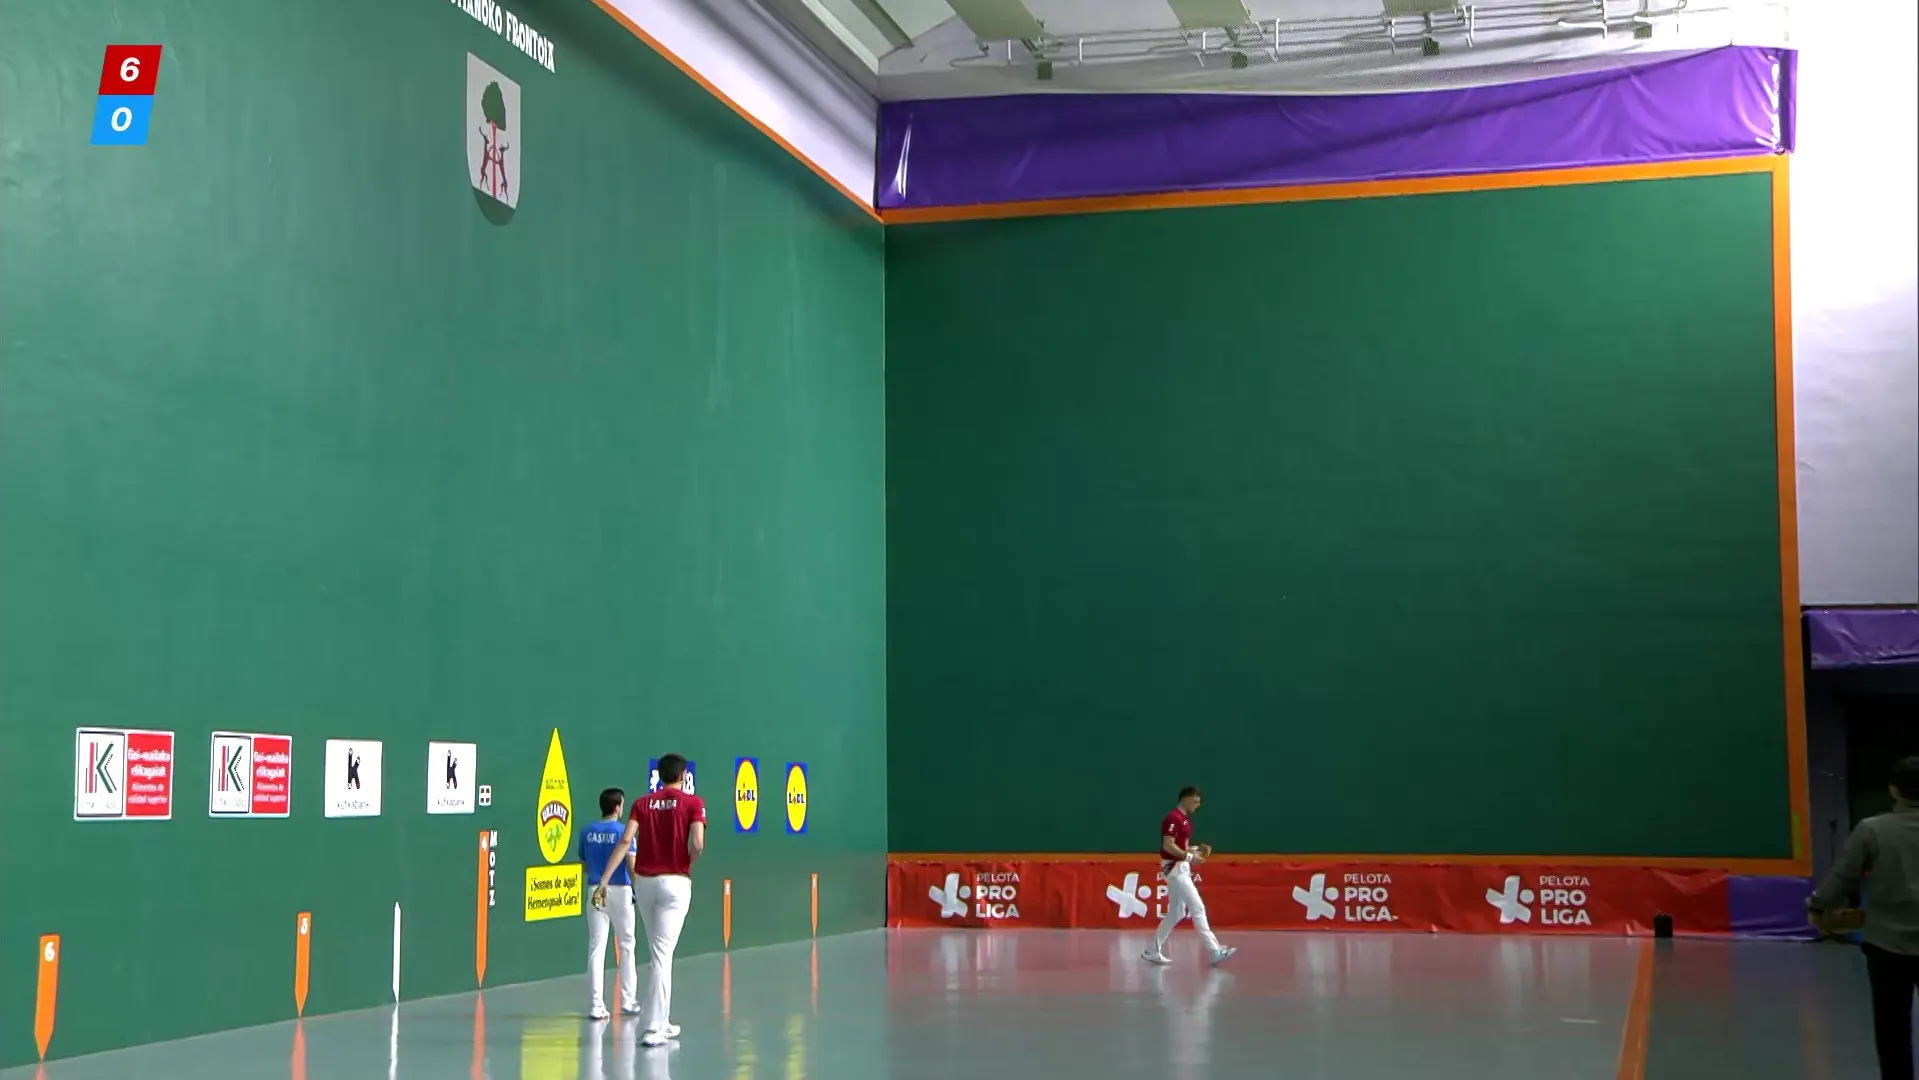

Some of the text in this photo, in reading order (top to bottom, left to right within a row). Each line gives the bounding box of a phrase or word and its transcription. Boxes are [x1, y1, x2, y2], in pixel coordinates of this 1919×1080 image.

[506, 10, 555, 73] FRONTOIA
[489, 830, 498, 907] MOTZ
[976, 872, 1020, 883] PELOTA
[1344, 873, 1392, 885] PELOTA
[1540, 875, 1591, 887] PELOTA
[976, 885, 1017, 900] PRO
[1344, 887, 1389, 903] PRO
[1540, 889, 1587, 906] PRO
[975, 903, 1020, 919] LIGA
[1344, 905, 1392, 922] LIGA
[1541, 907, 1592, 925] LIGA
[44, 941, 55, 962] 6
